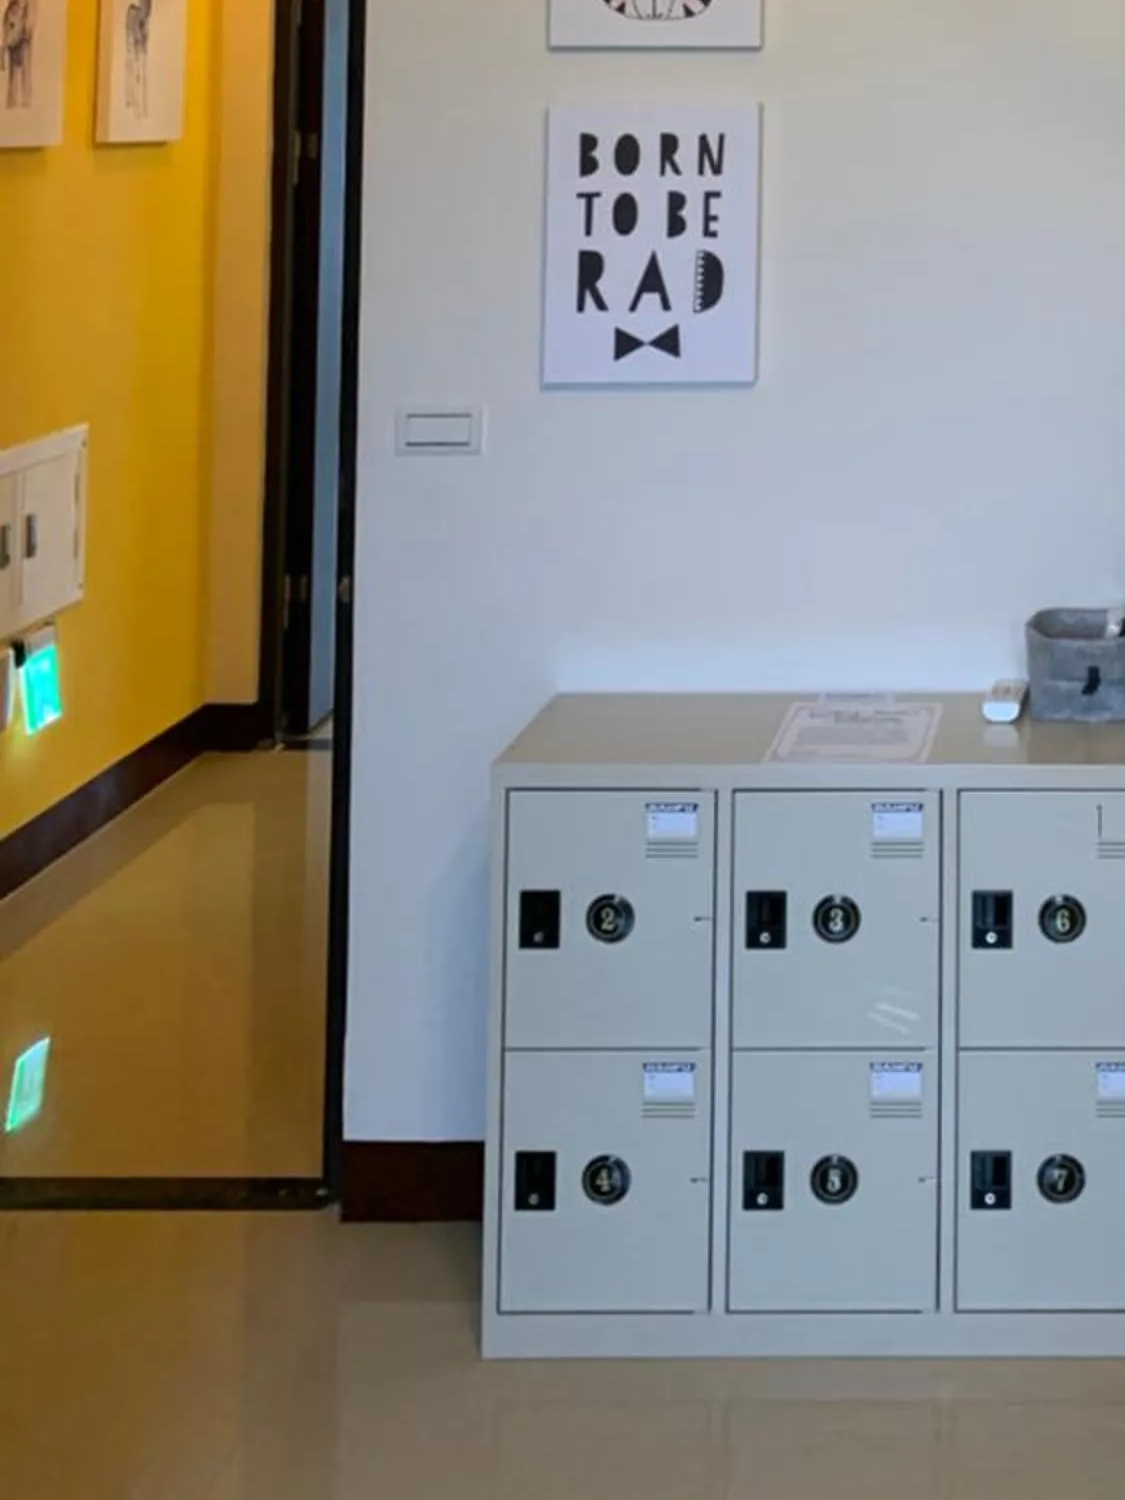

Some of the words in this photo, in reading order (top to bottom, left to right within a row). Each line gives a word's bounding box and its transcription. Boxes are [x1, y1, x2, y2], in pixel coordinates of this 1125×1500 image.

[578, 132, 725, 177] BORN
[576, 191, 638, 237] TO
[667, 190, 722, 238] BE
[576, 249, 725, 313] RAD
[600, 907, 616, 931] 2
[829, 907, 844, 932] 3
[1056, 908, 1071, 932] 6
[595, 1168, 611, 1192] 4
[826, 1169, 842, 1193] 5
[1053, 1168, 1069, 1192] 7
